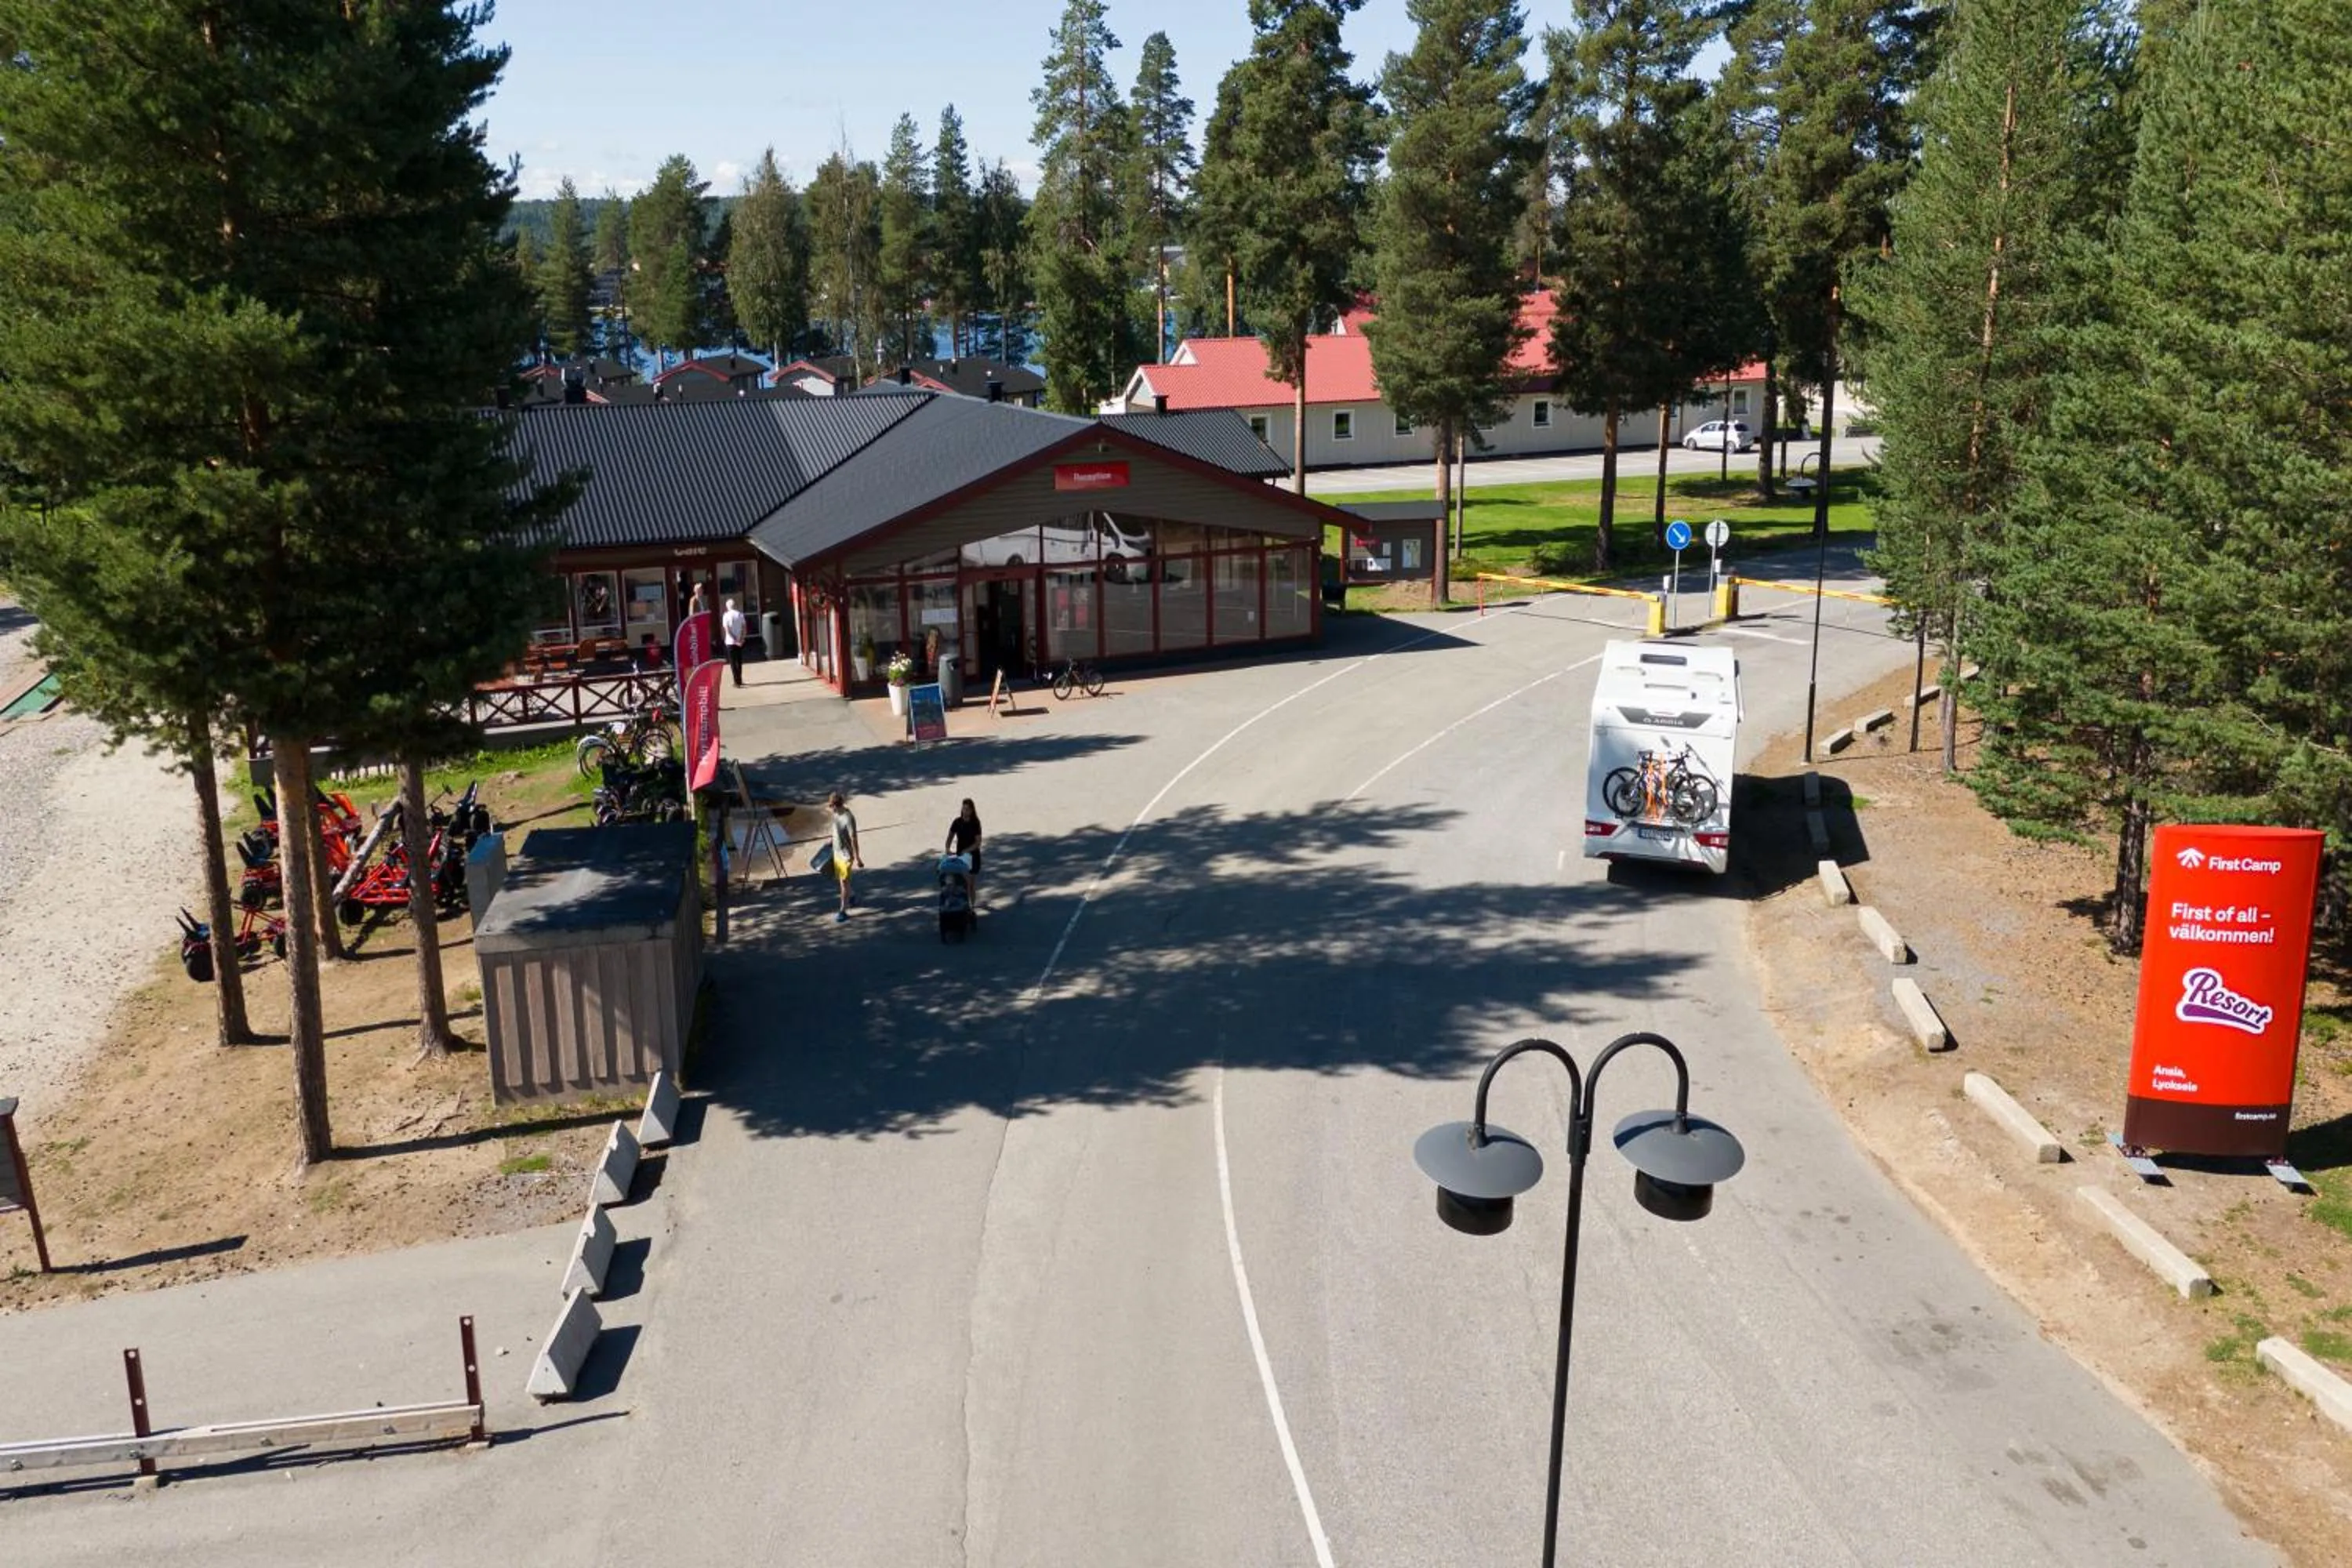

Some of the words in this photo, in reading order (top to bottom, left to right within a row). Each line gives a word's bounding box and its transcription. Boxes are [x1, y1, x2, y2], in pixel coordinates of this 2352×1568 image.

[2209, 856, 2241, 871] First
[2241, 858, 2281, 874] Camp
[2171, 902, 2212, 921] First
[2215, 906, 2235, 922] of
[2236, 906, 2257, 923] all
[2169, 924, 2274, 943] välkommen!
[2188, 971, 2269, 1024] Resort
